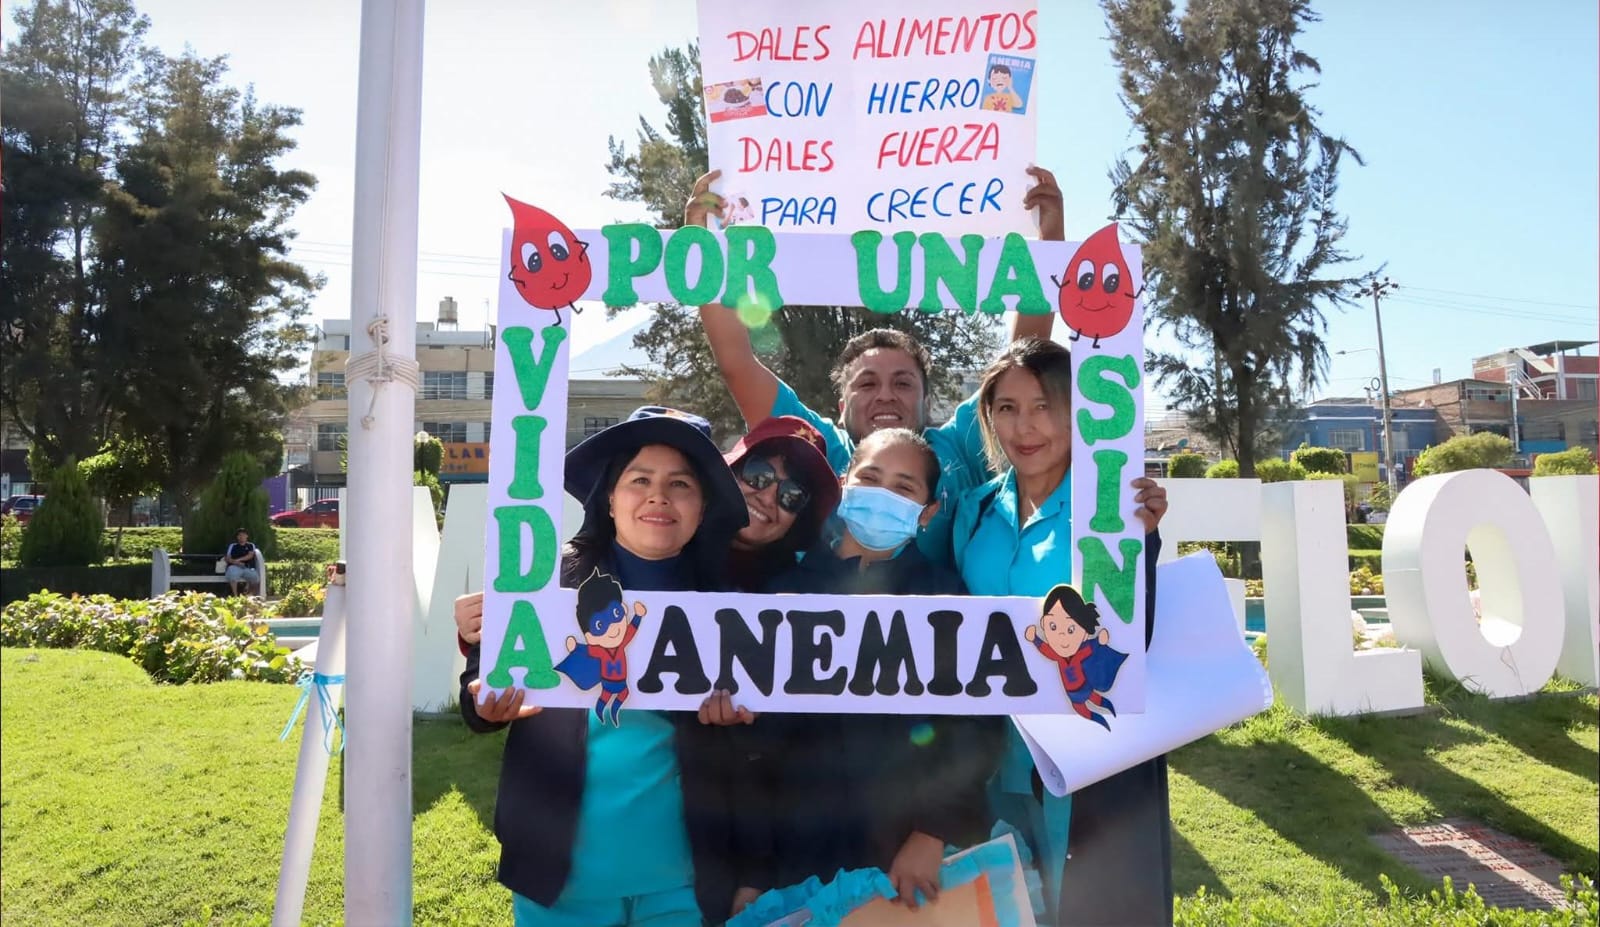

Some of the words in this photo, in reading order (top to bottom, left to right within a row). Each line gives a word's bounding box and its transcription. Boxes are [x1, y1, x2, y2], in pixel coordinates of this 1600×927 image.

[728, 25, 831, 62] DALES
[853, 10, 1037, 59] ALIMENTOS
[765, 81, 833, 117] CON
[868, 78, 980, 114] HIERRO
[738, 137, 835, 173] DALES
[878, 122, 1000, 169] FUERZA
[761, 196, 837, 226] PARA
[867, 178, 1003, 223] CRECER
[601, 223, 784, 312] POR
[852, 230, 1052, 315] UNA
[488, 327, 567, 689] VIDA
[1077, 354, 1143, 623] SIN
[638, 605, 1038, 697] ANEMIA
